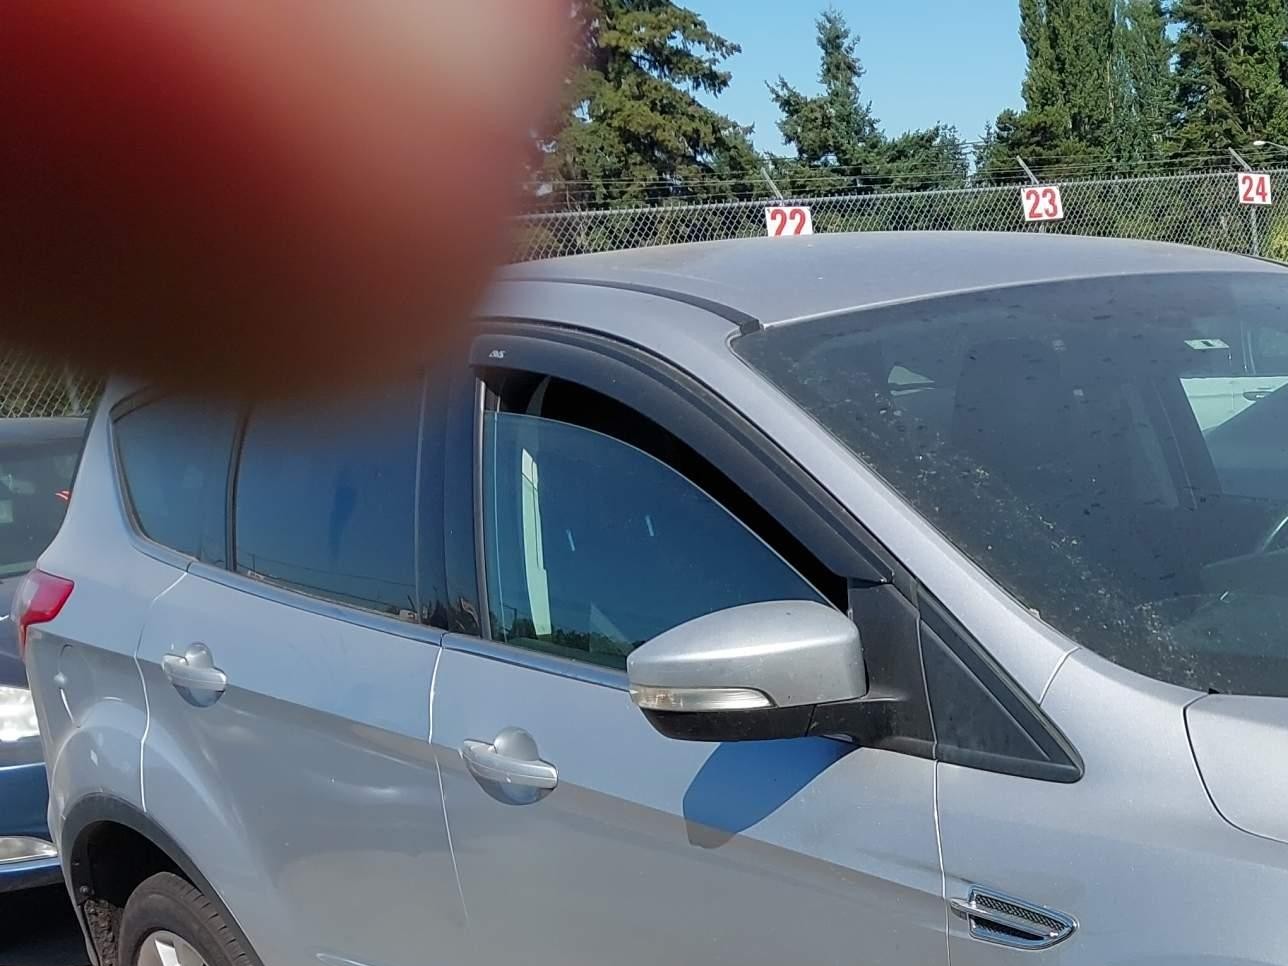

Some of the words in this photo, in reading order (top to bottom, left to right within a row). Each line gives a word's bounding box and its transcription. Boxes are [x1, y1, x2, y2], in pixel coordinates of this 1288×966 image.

[1242, 176, 1267, 202] 24
[1025, 188, 1058, 219] 23
[771, 208, 806, 236] 22
